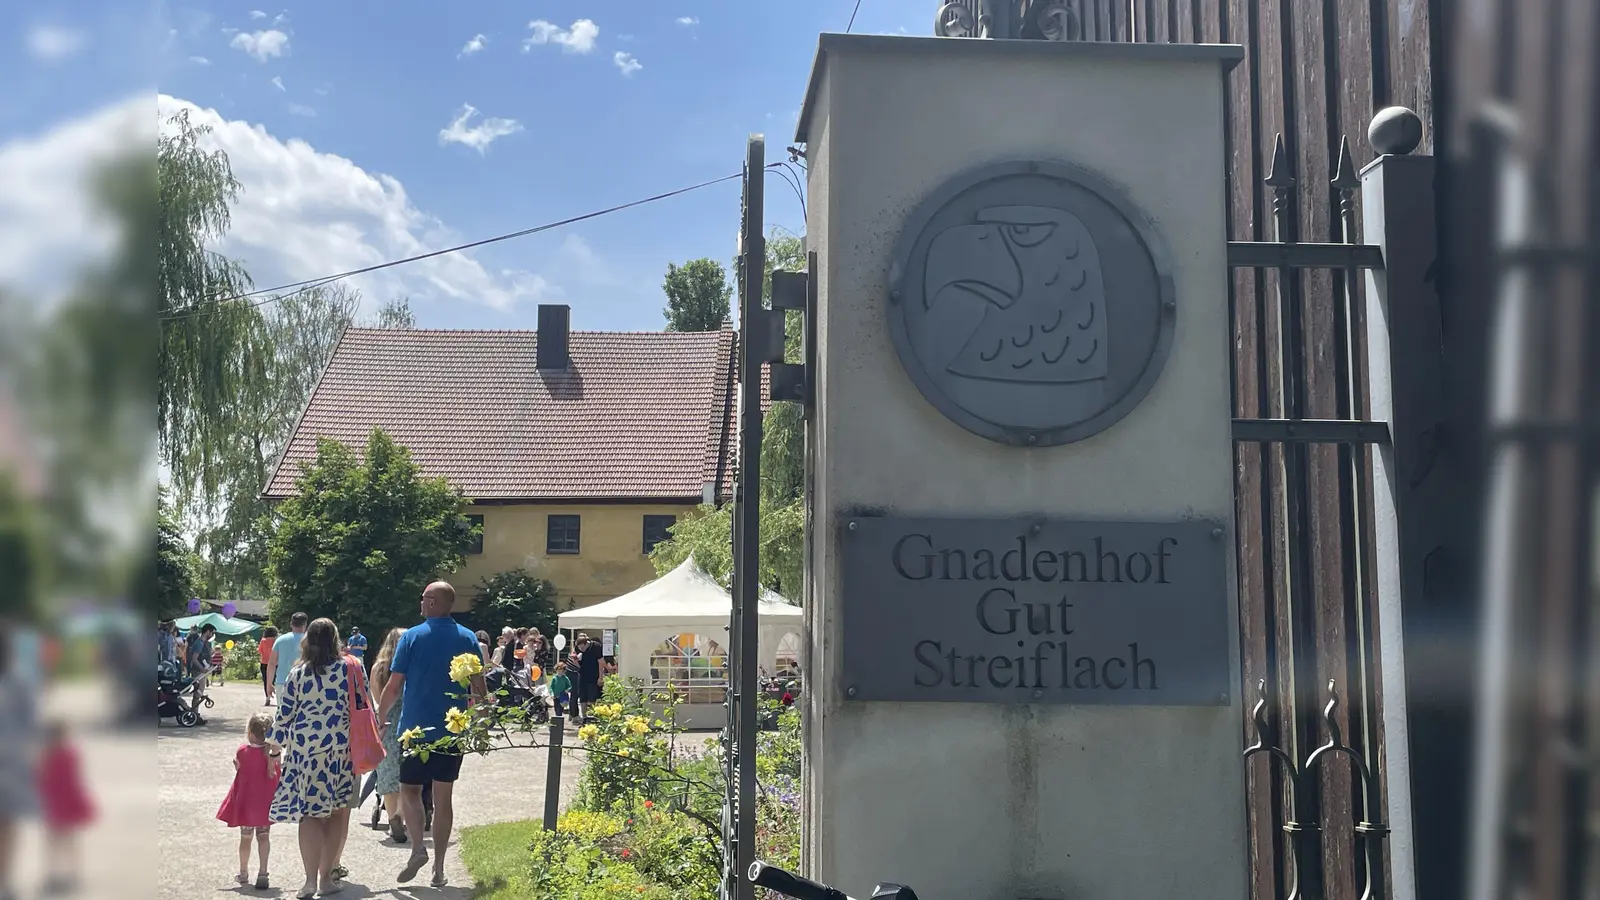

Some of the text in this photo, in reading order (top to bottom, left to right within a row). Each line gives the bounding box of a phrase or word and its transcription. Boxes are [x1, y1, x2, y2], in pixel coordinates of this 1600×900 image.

[892, 533, 1178, 584] Gnadenhof
[975, 587, 1074, 635] Gut
[913, 640, 1159, 690] Streiflach
